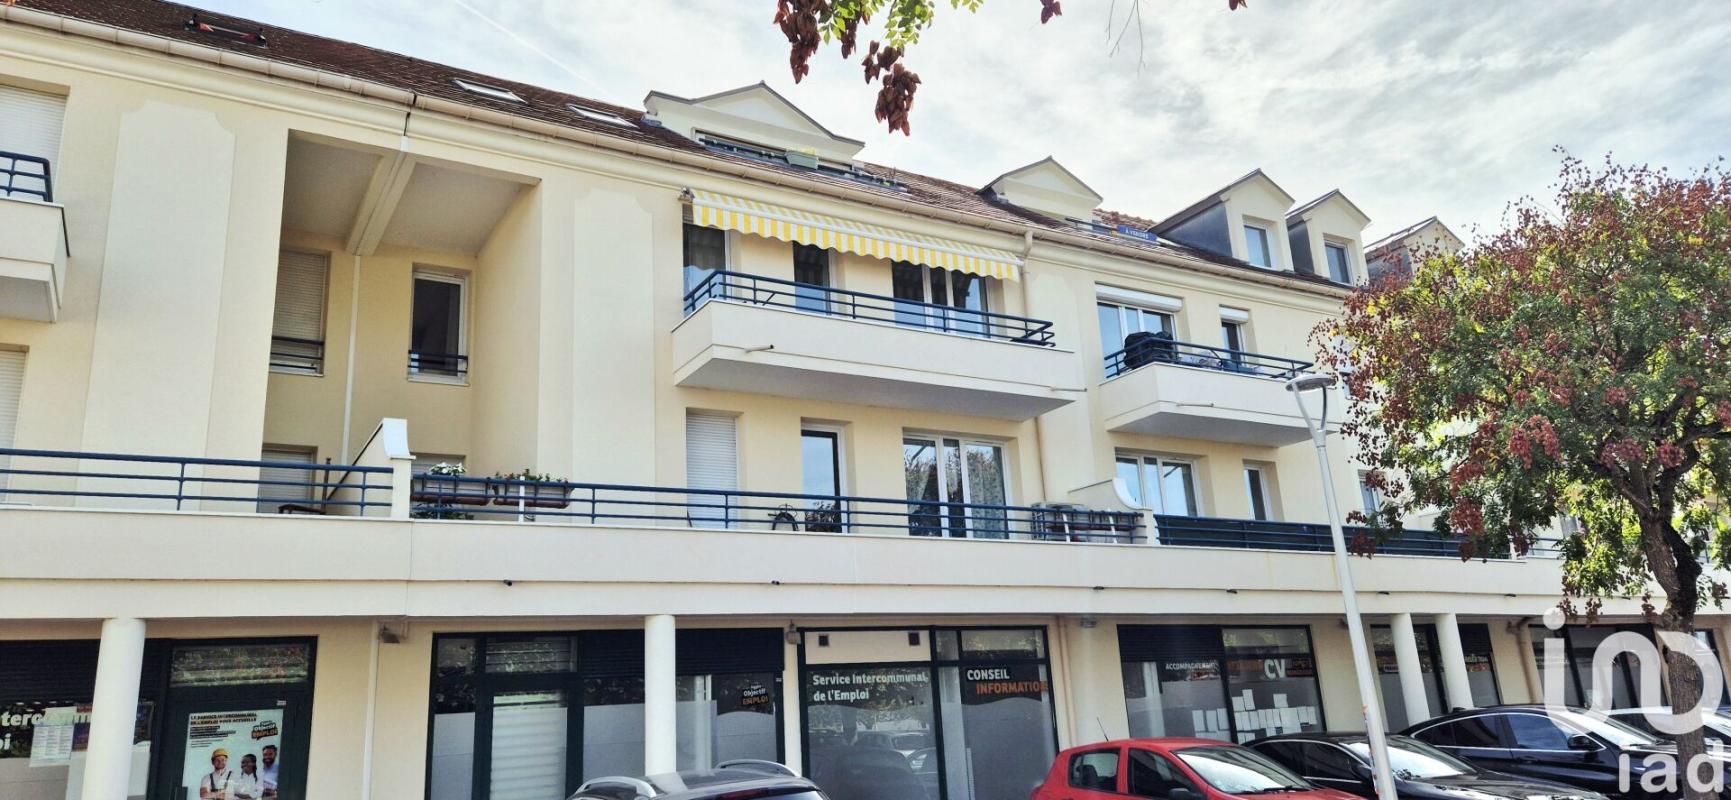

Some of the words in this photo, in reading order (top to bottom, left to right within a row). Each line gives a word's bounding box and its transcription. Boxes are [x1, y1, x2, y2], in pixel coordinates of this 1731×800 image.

[966, 668, 1010, 680] CONSEIL
[1264, 658, 1286, 679] CV
[812, 673, 851, 685] Service
[852, 671, 928, 684] Intercommunal
[813, 690, 826, 702] de
[827, 688, 870, 703] l'Emploi
